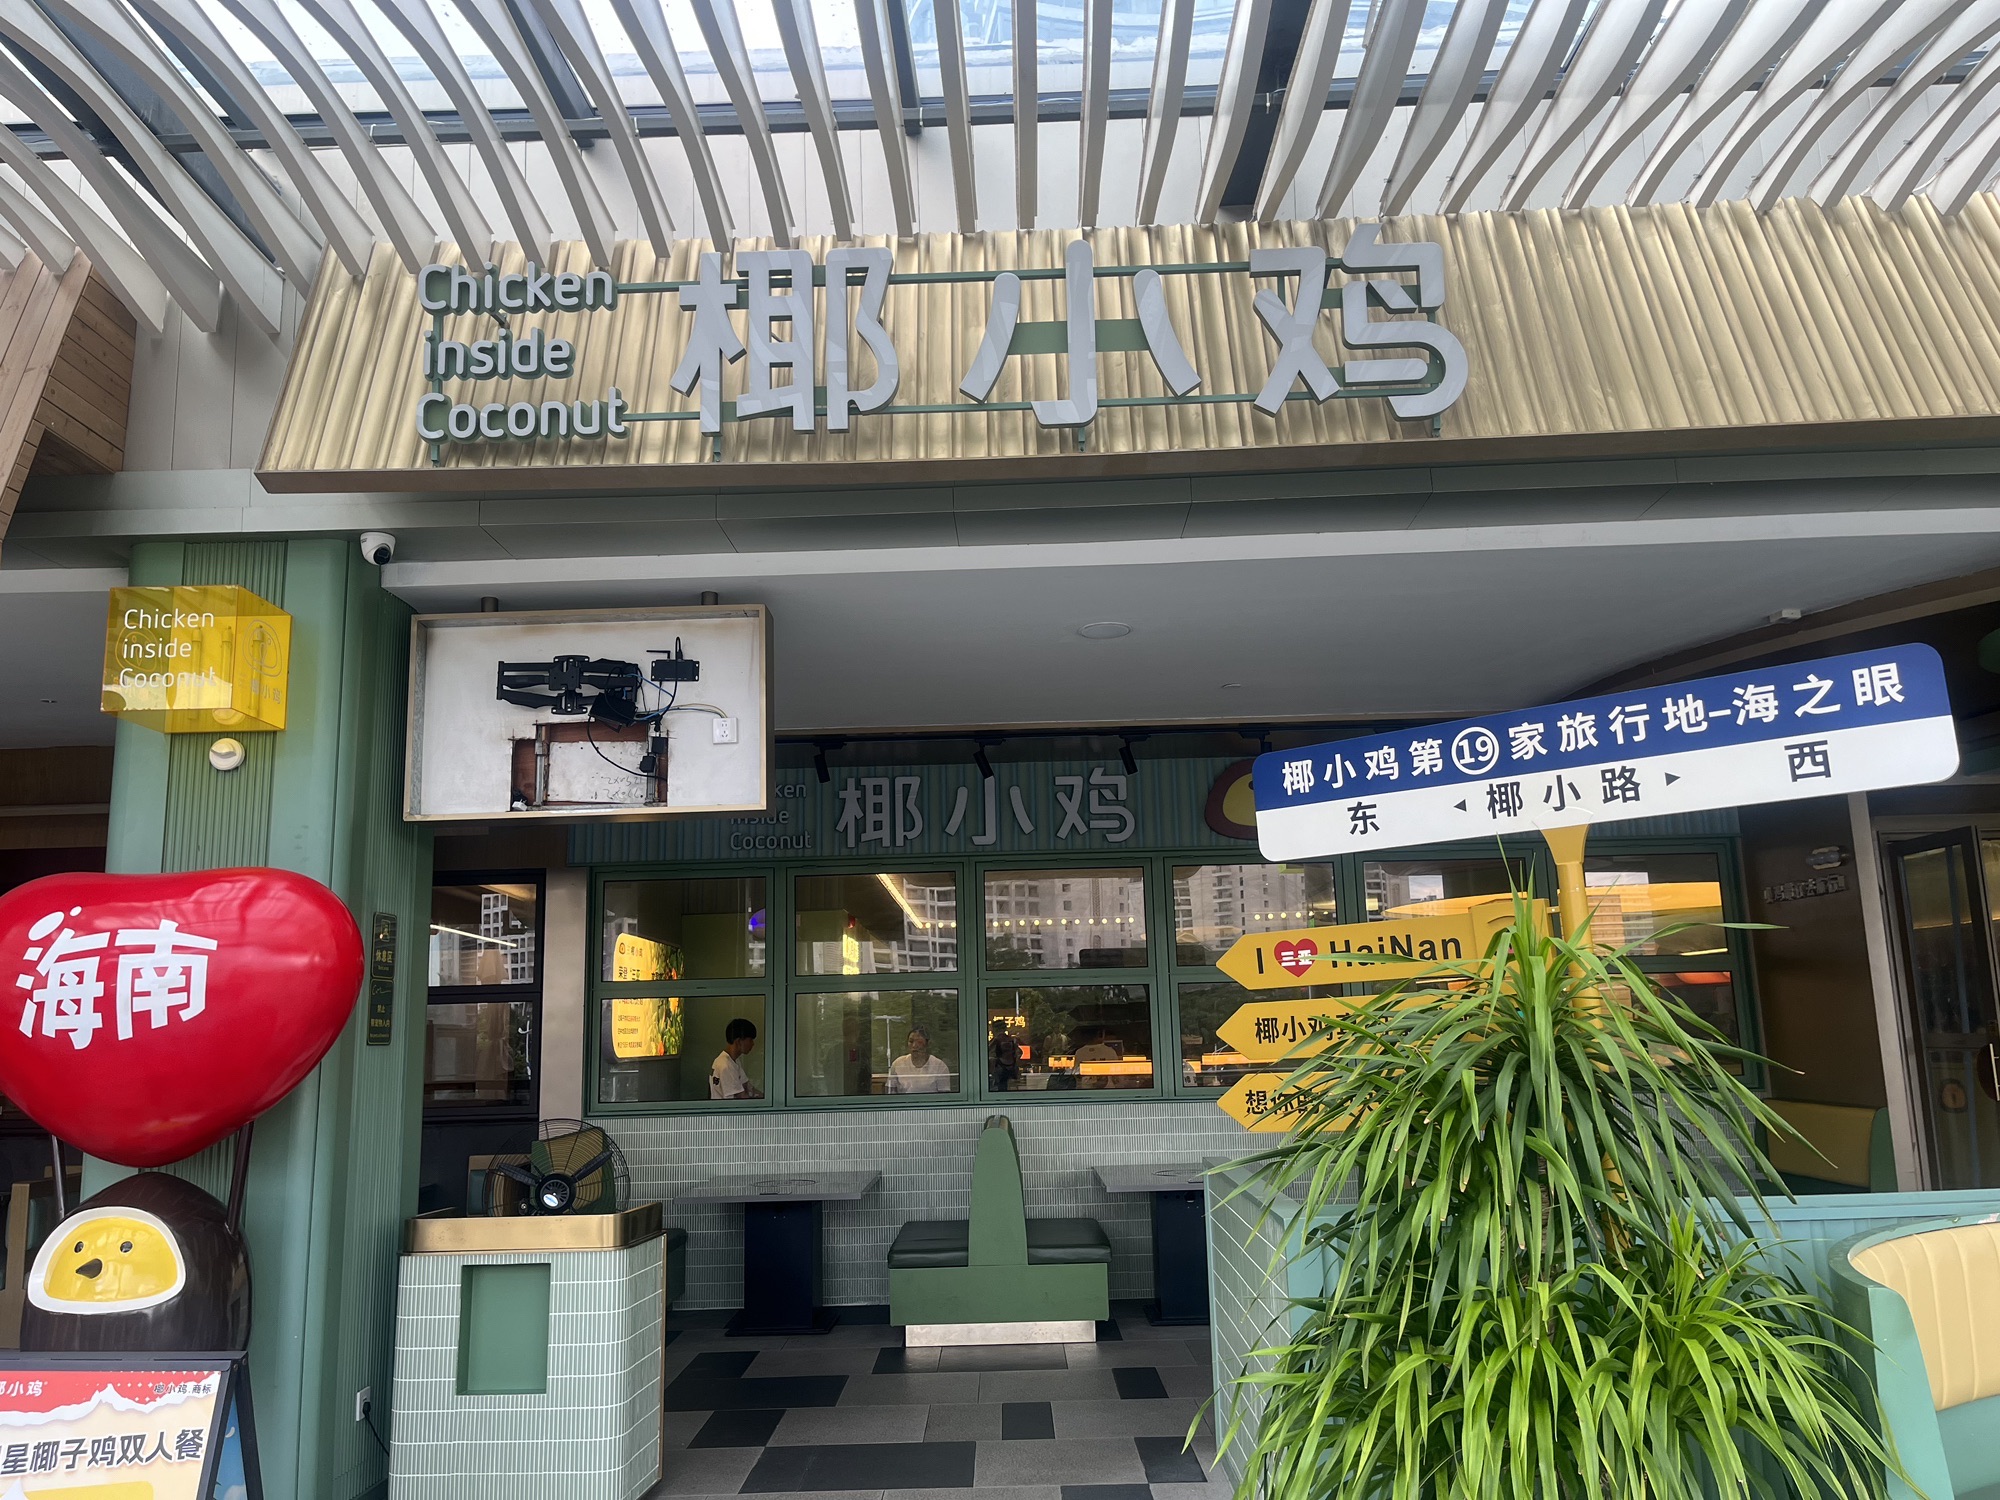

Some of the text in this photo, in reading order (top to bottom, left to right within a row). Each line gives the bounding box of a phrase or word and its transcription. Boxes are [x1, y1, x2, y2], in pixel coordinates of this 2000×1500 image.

[418, 261, 614, 310] Chicken
[423, 327, 571, 375] inside
[669, 224, 1469, 437] 椰小鸡
[416, 387, 626, 439] Coconut
[124, 608, 215, 630] Chicken
[123, 638, 192, 659] inside
[119, 666, 217, 689] Coconut
[836, 768, 1136, 848] 椰小鸡
[1348, 740, 1834, 836] 东 椰小路 西
[730, 831, 812, 850] Coconut
[1256, 934, 1462, 974] I 三亚 HaiNan
[16, 915, 218, 1050] 海南
[0, 1429, 204, 1475] 星椰子鸡双人餐
